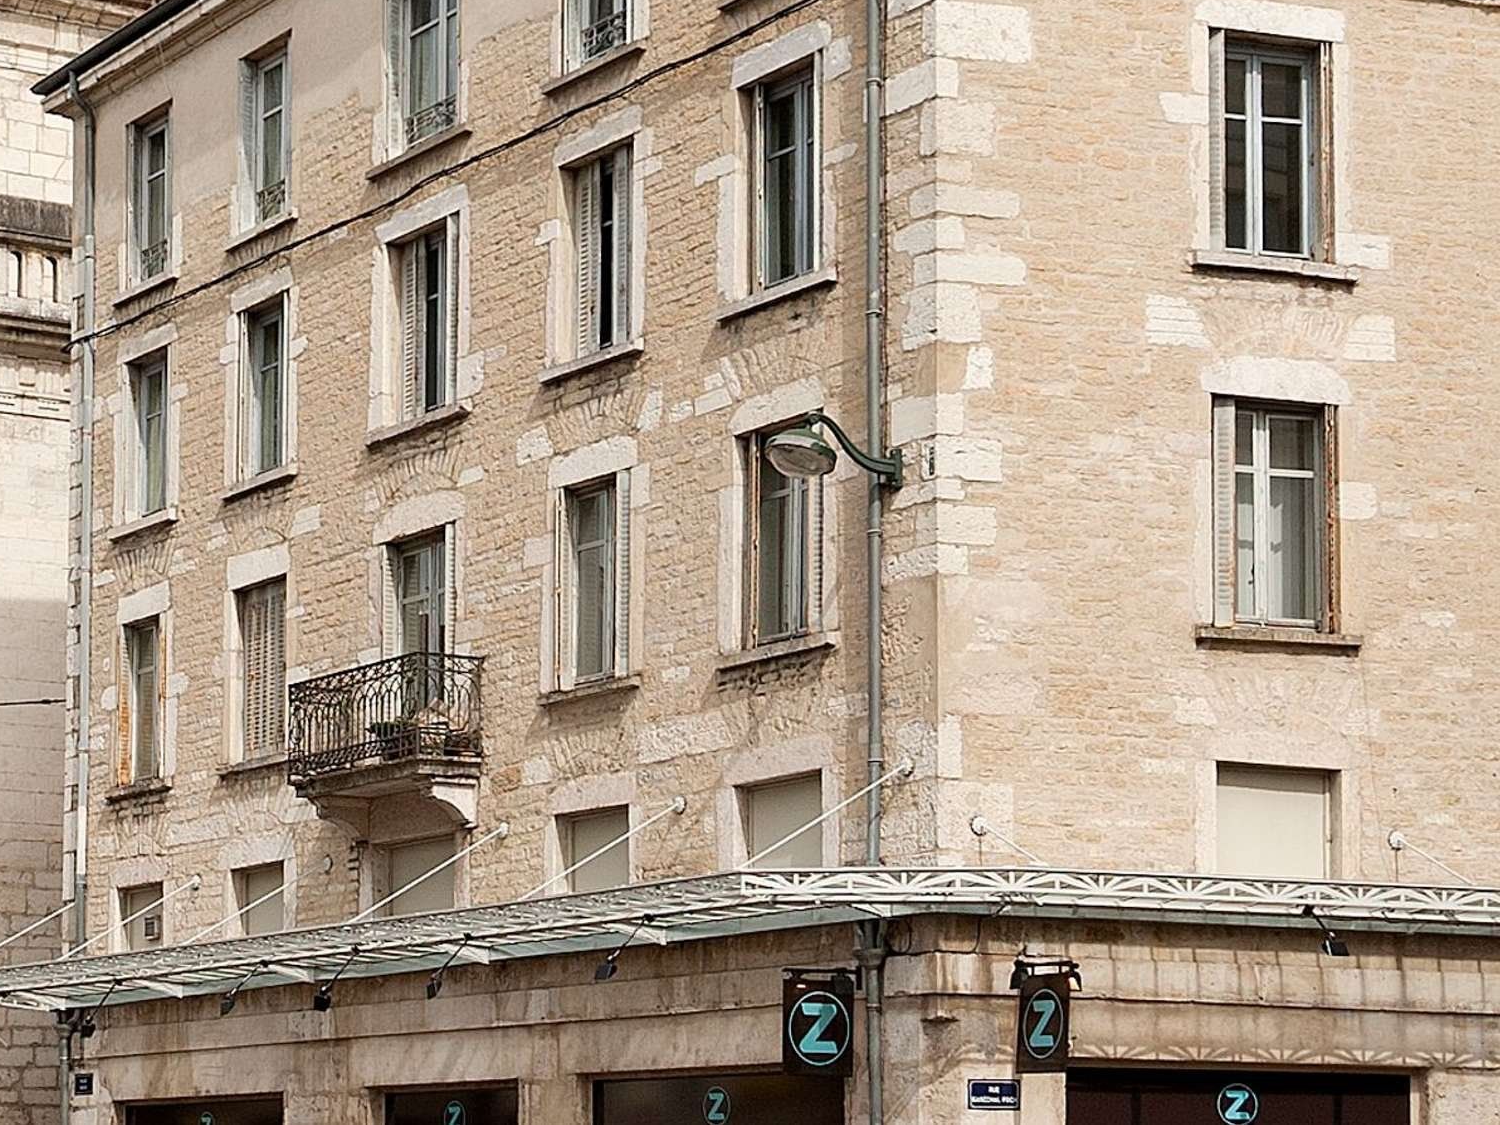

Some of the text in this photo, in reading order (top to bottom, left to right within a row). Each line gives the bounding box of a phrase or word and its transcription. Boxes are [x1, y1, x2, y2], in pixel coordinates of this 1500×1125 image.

[799, 1002, 839, 1055] Z
[1029, 999, 1056, 1048] Z
[708, 1092, 725, 1121] Z
[1225, 1090, 1250, 1120] Z
